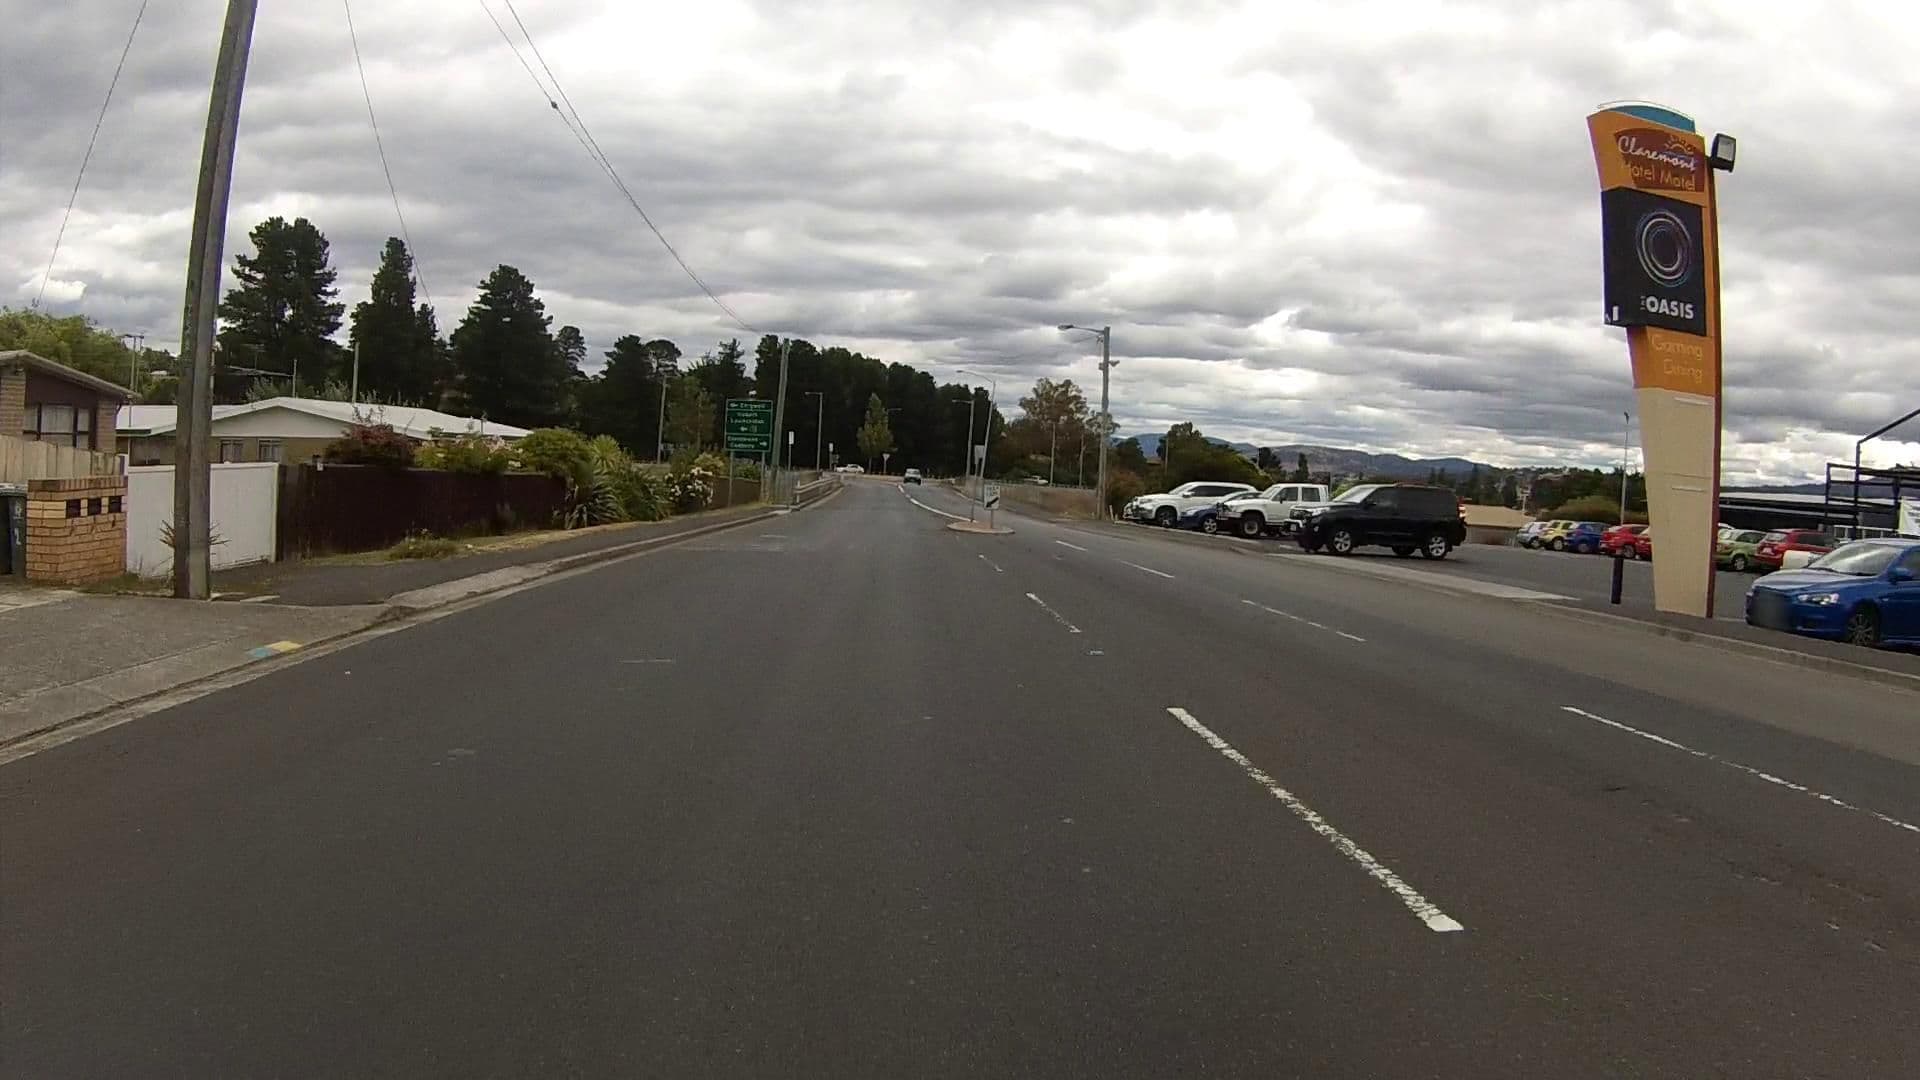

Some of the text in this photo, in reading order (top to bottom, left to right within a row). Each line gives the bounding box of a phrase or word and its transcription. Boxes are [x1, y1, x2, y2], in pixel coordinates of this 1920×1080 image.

[1618, 136, 1697, 171] Claremont
[1620, 156, 1696, 191] Hotel Motel
[1646, 295, 1694, 319] OASIS
[1651, 333, 1703, 361] Gaming
[1663, 358, 1703, 384] Dining
